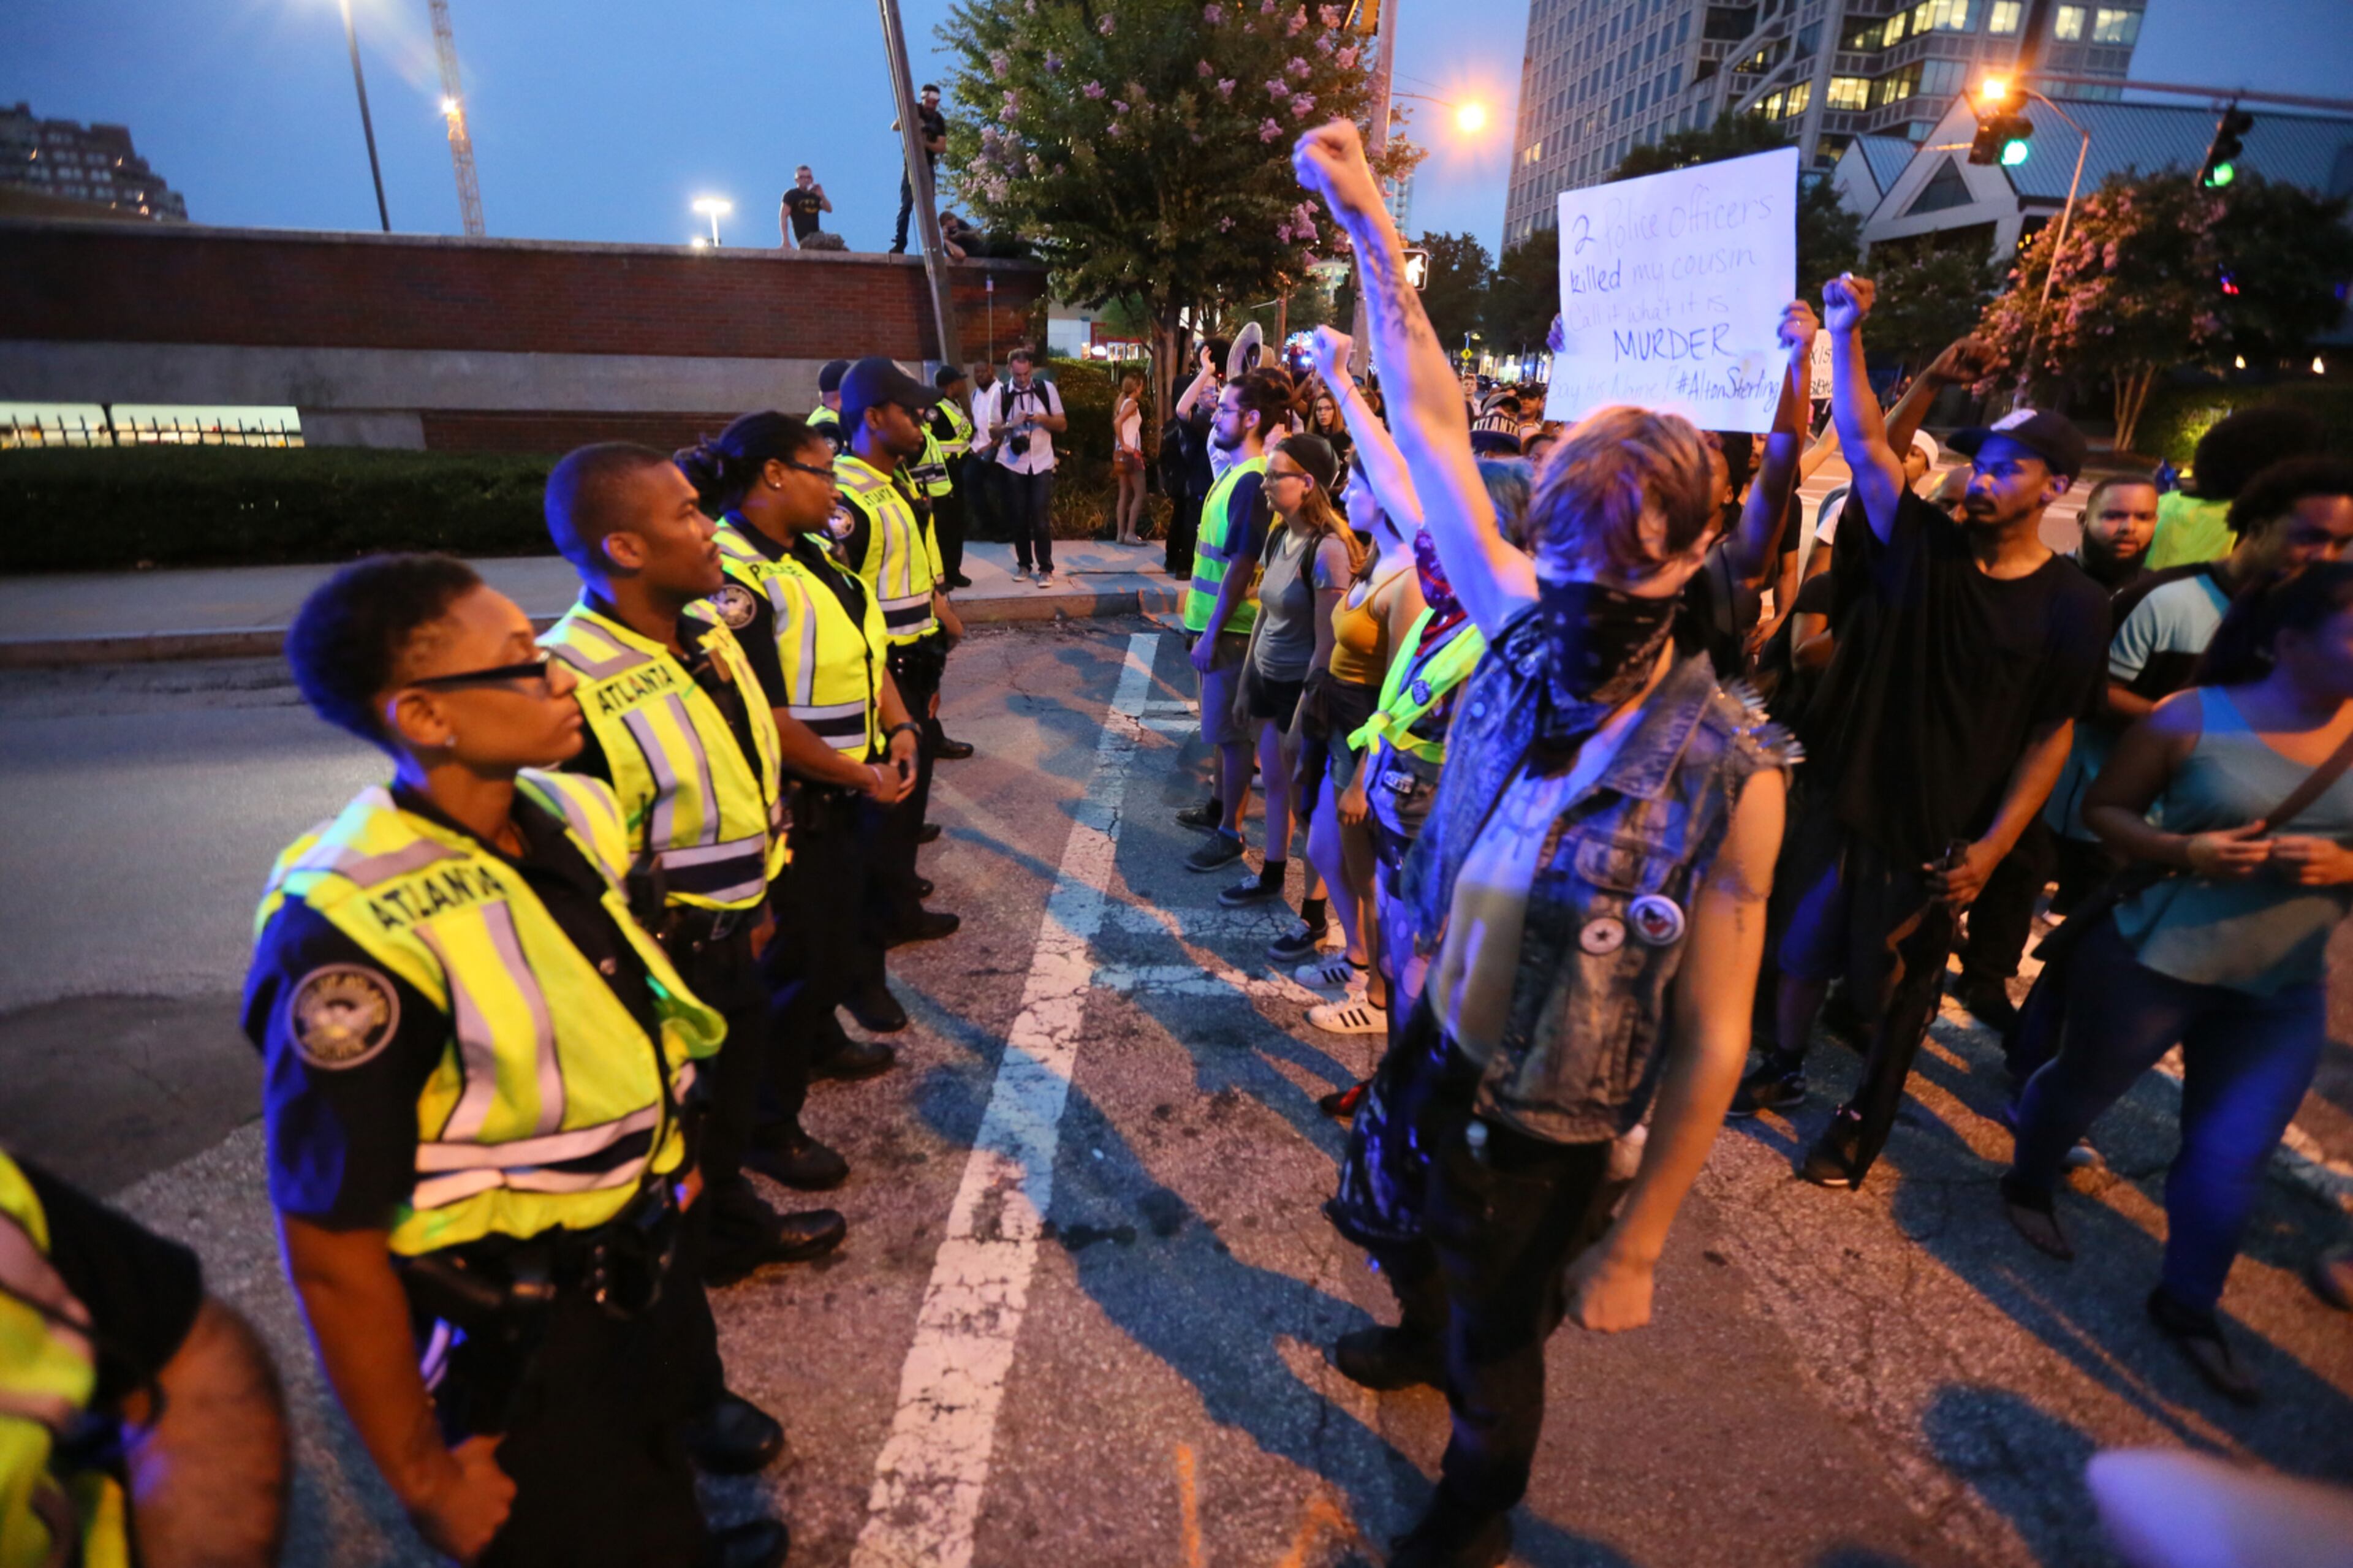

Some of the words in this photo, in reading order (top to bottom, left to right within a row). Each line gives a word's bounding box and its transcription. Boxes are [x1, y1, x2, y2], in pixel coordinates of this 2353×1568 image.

[1572, 214, 1598, 256] 2
[1603, 197, 1659, 255] Police
[1668, 183, 1774, 238] Officers
[1570, 258, 1621, 295] killed
[1632, 263, 1664, 302] my
[1671, 241, 1757, 281] cousin
[1569, 303, 1602, 332] Call
[1627, 297, 1672, 324] what
[1681, 291, 1697, 315] it
[1613, 322, 1739, 362] MURDER
[1677, 366, 1779, 413] #AltonSterling
[1472, 416, 1520, 437] ATLANTA
[597, 664, 676, 716] ATLANTA
[368, 866, 508, 931] ATLANTA
